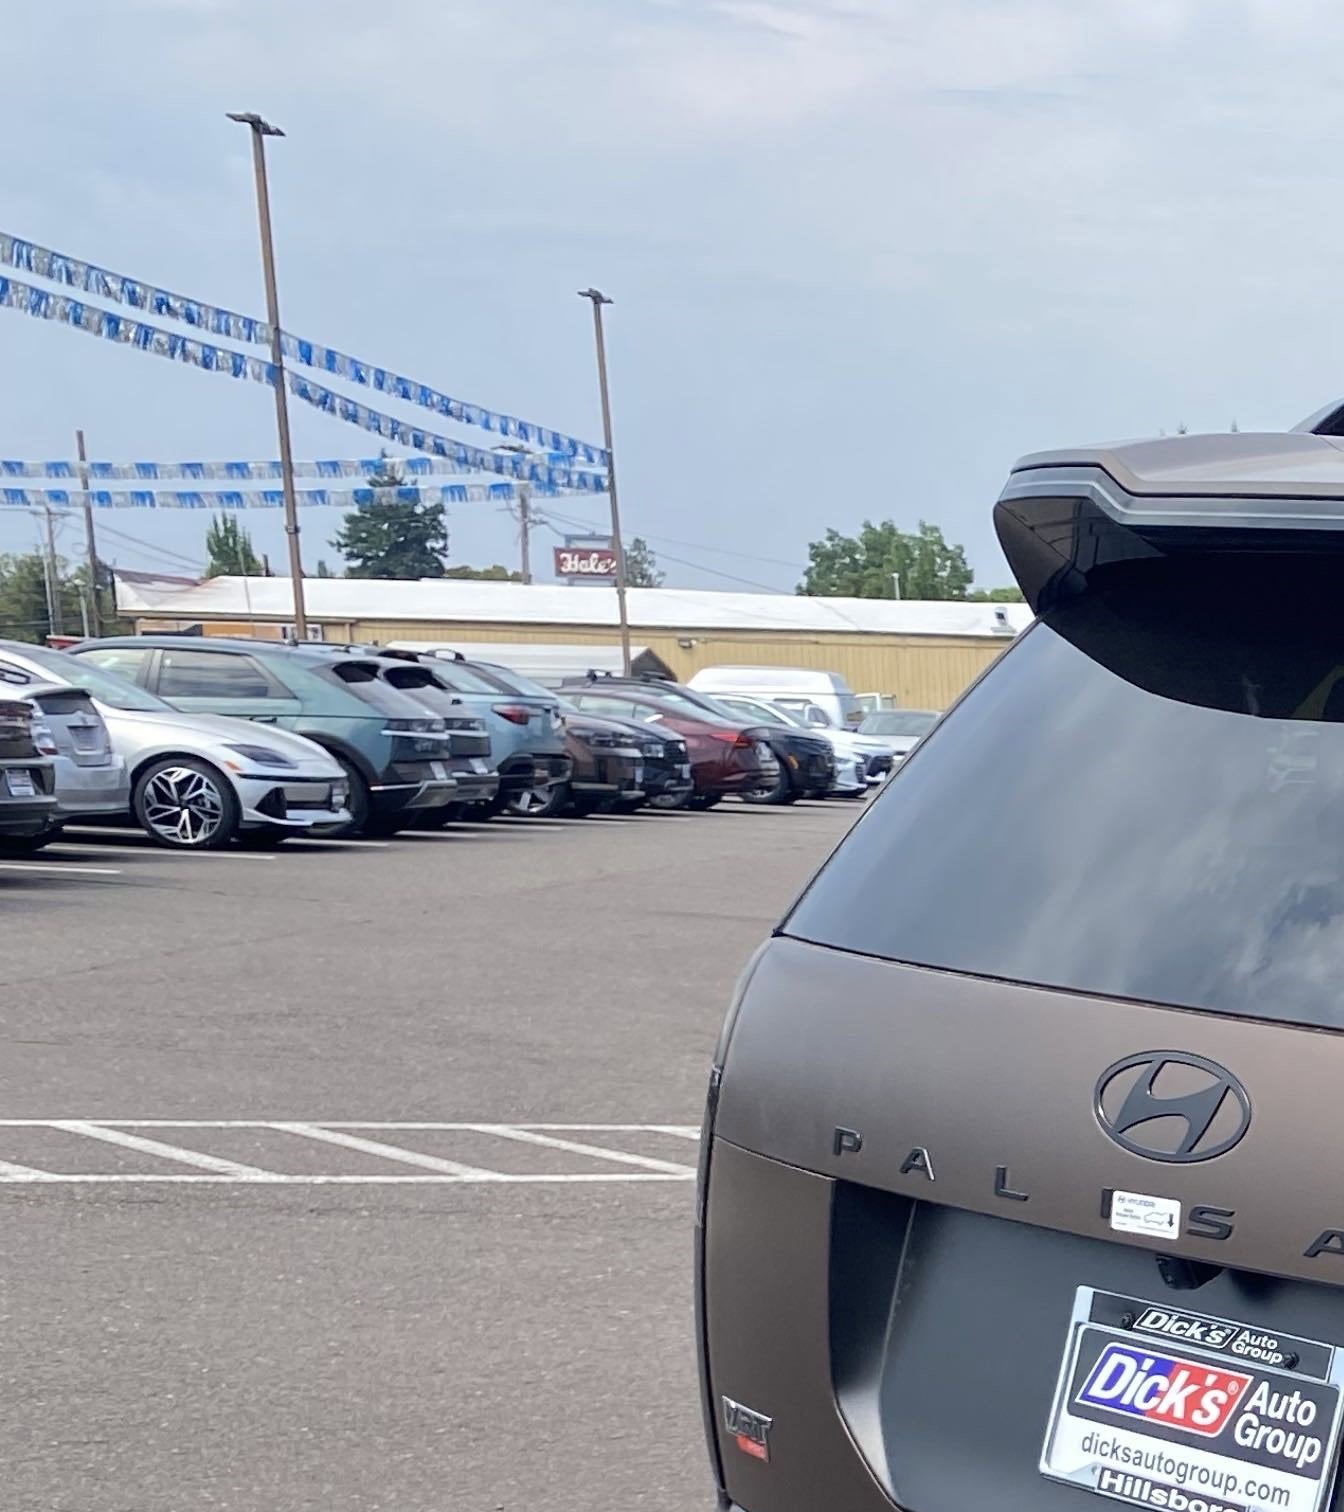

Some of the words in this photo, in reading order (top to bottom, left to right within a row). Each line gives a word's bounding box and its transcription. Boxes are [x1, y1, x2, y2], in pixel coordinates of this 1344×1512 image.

[1231, 1340, 1284, 1364] Group
[1237, 1330, 1279, 1350] Auto
[1244, 1381, 1317, 1426] Auto
[1233, 1413, 1322, 1469] Group
[1081, 1431, 1291, 1506] dicksautogroup.com
